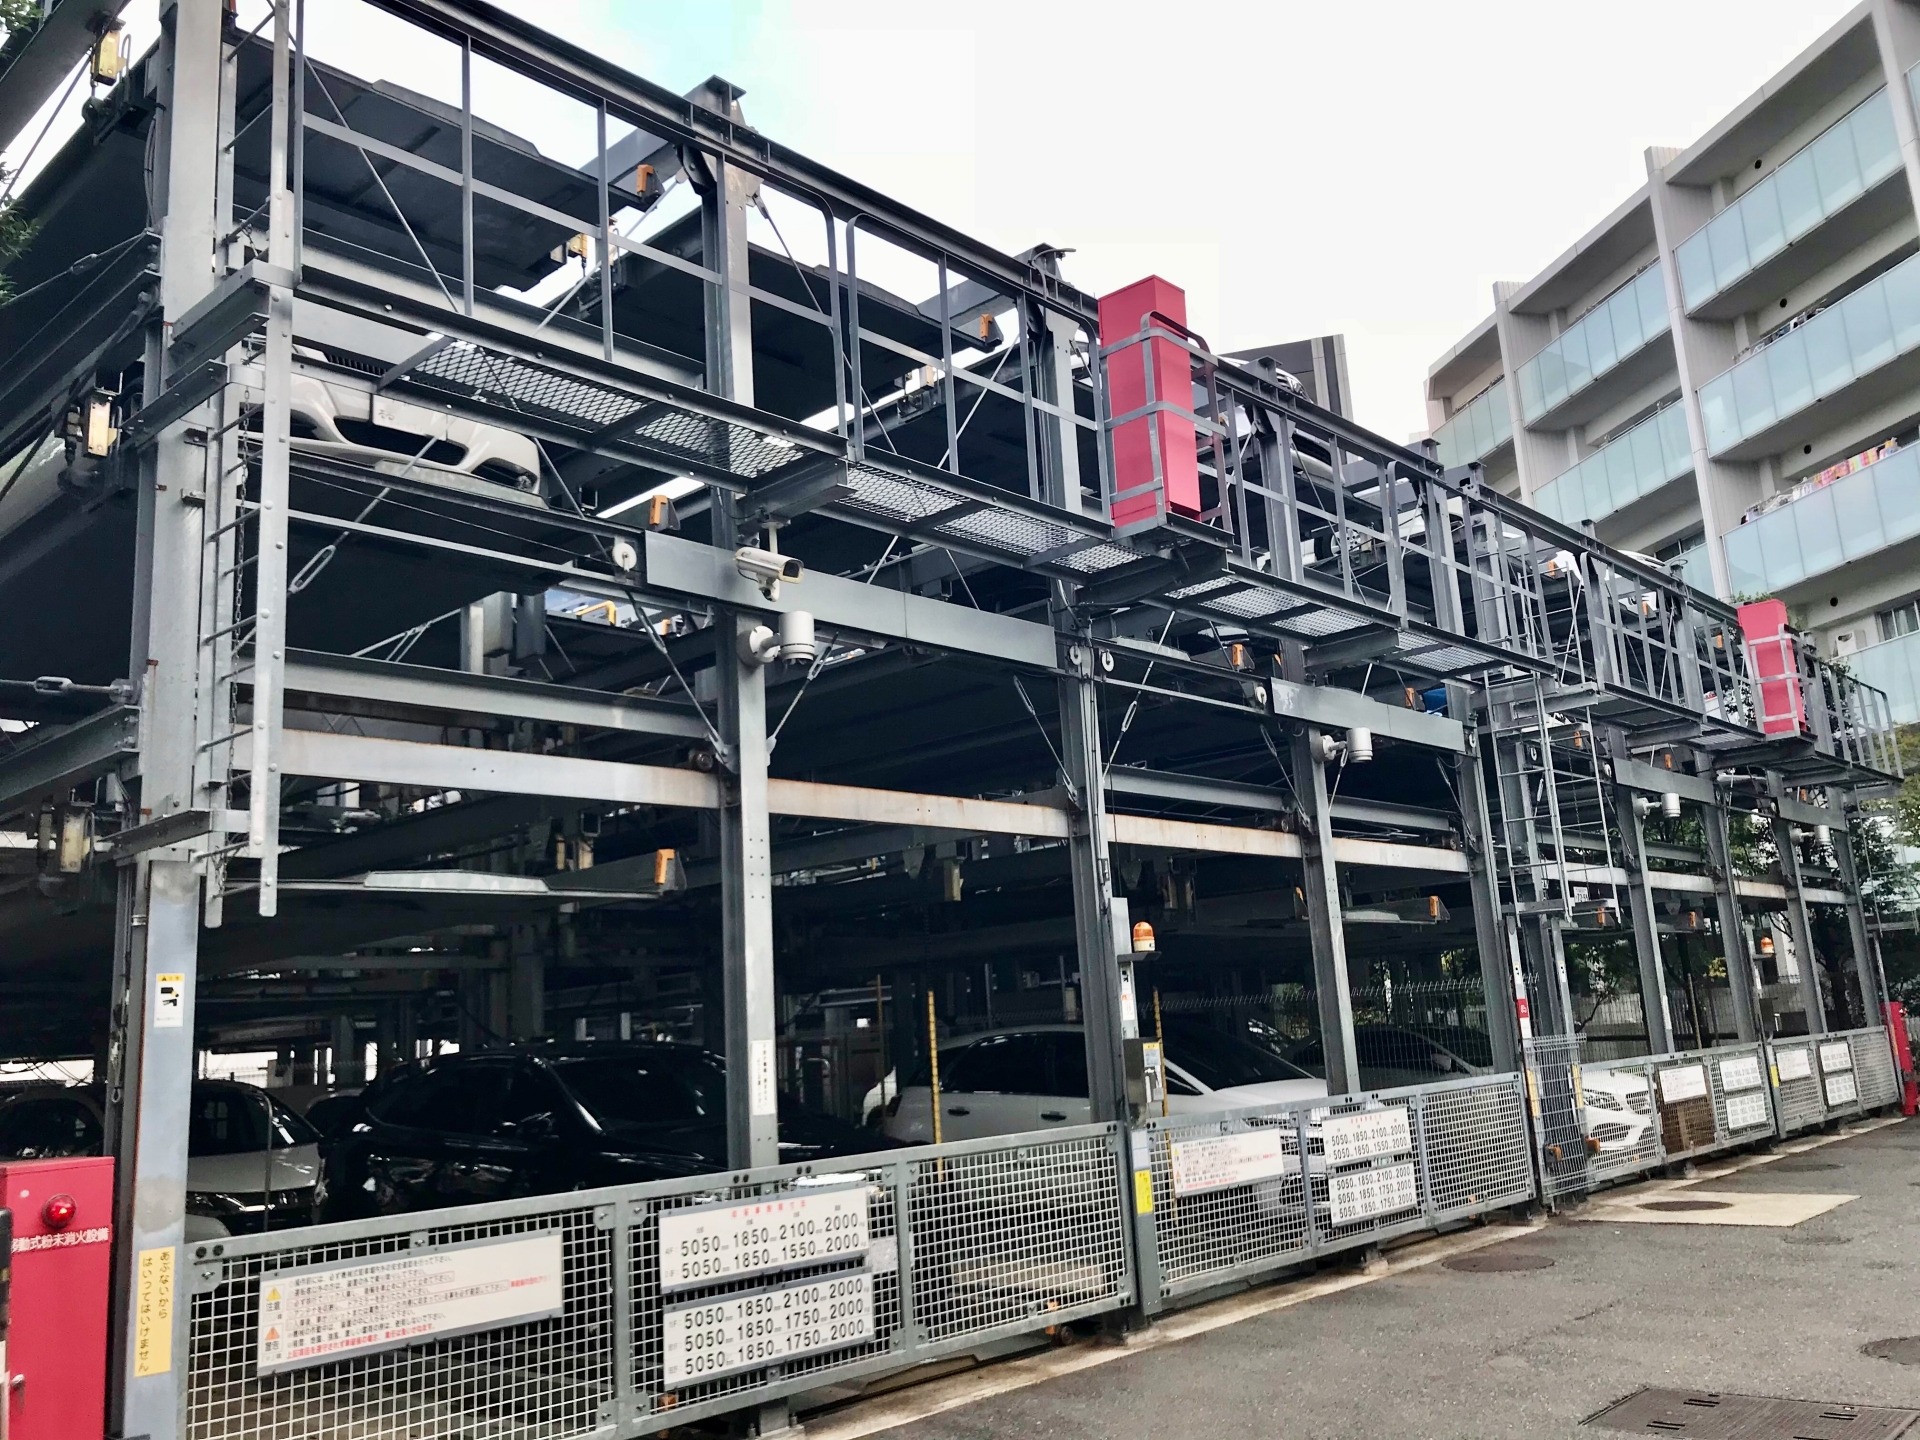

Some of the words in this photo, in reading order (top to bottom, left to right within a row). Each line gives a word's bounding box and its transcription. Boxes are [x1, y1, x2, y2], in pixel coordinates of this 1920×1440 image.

[138, 1257, 152, 1372] はいってはいけません
[158, 1252, 171, 1319] あぶないから
